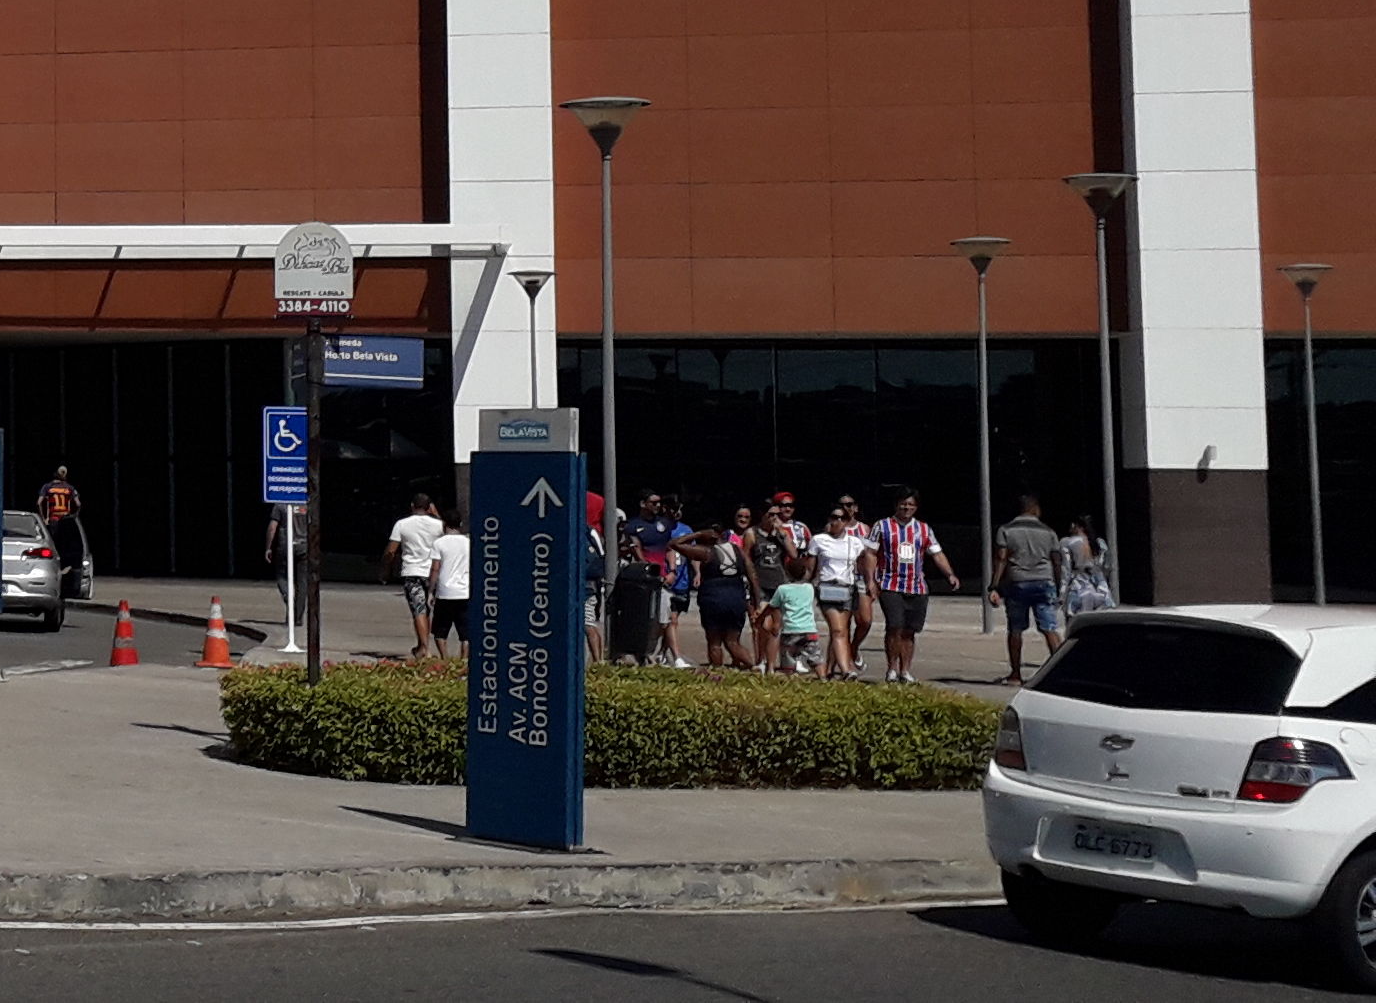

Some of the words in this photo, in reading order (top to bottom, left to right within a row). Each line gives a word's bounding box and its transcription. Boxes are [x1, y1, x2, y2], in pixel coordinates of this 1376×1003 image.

[352, 351, 374, 360] Bela
[375, 353, 398, 362] Vista
[53, 494, 67, 508] 11
[529, 532, 554, 638] (Centro)
[477, 515, 499, 734] Estacionamento
[508, 642, 528, 702] ACM
[528, 648, 549, 747] Bonocô
[508, 708, 527, 745] Av.
